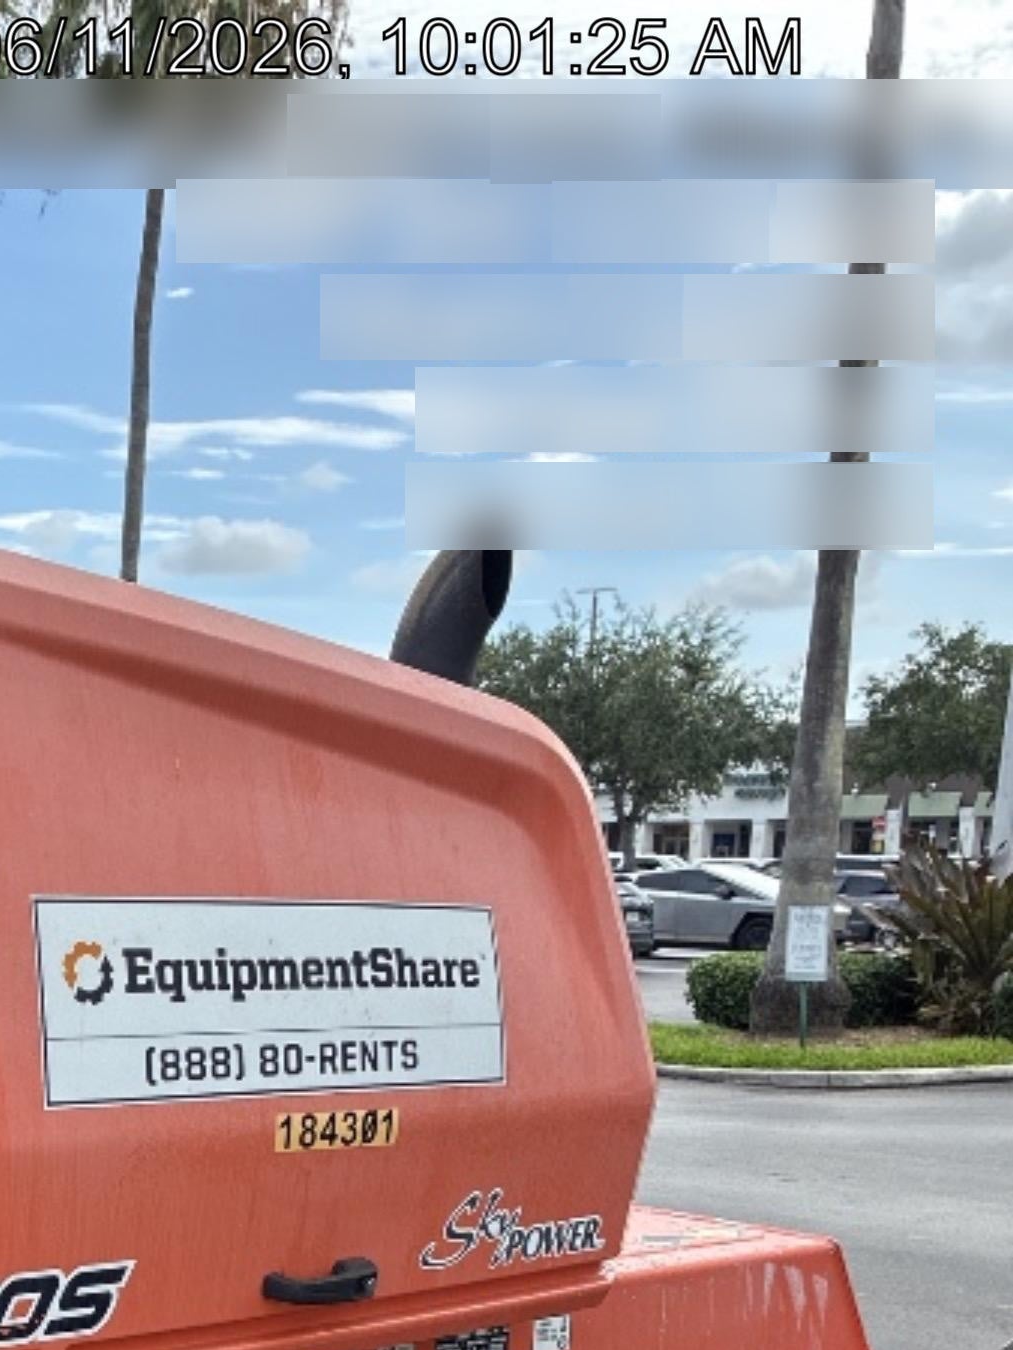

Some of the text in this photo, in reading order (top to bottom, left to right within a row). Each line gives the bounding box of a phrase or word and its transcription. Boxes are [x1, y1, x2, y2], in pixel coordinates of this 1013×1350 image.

[121, 947, 481, 1002] EquipmentShare
[144, 1039, 420, 1086] (888) 80-RENTS
[278, 1110, 395, 1150] 184301
[503, 1214, 606, 1264] POWER
